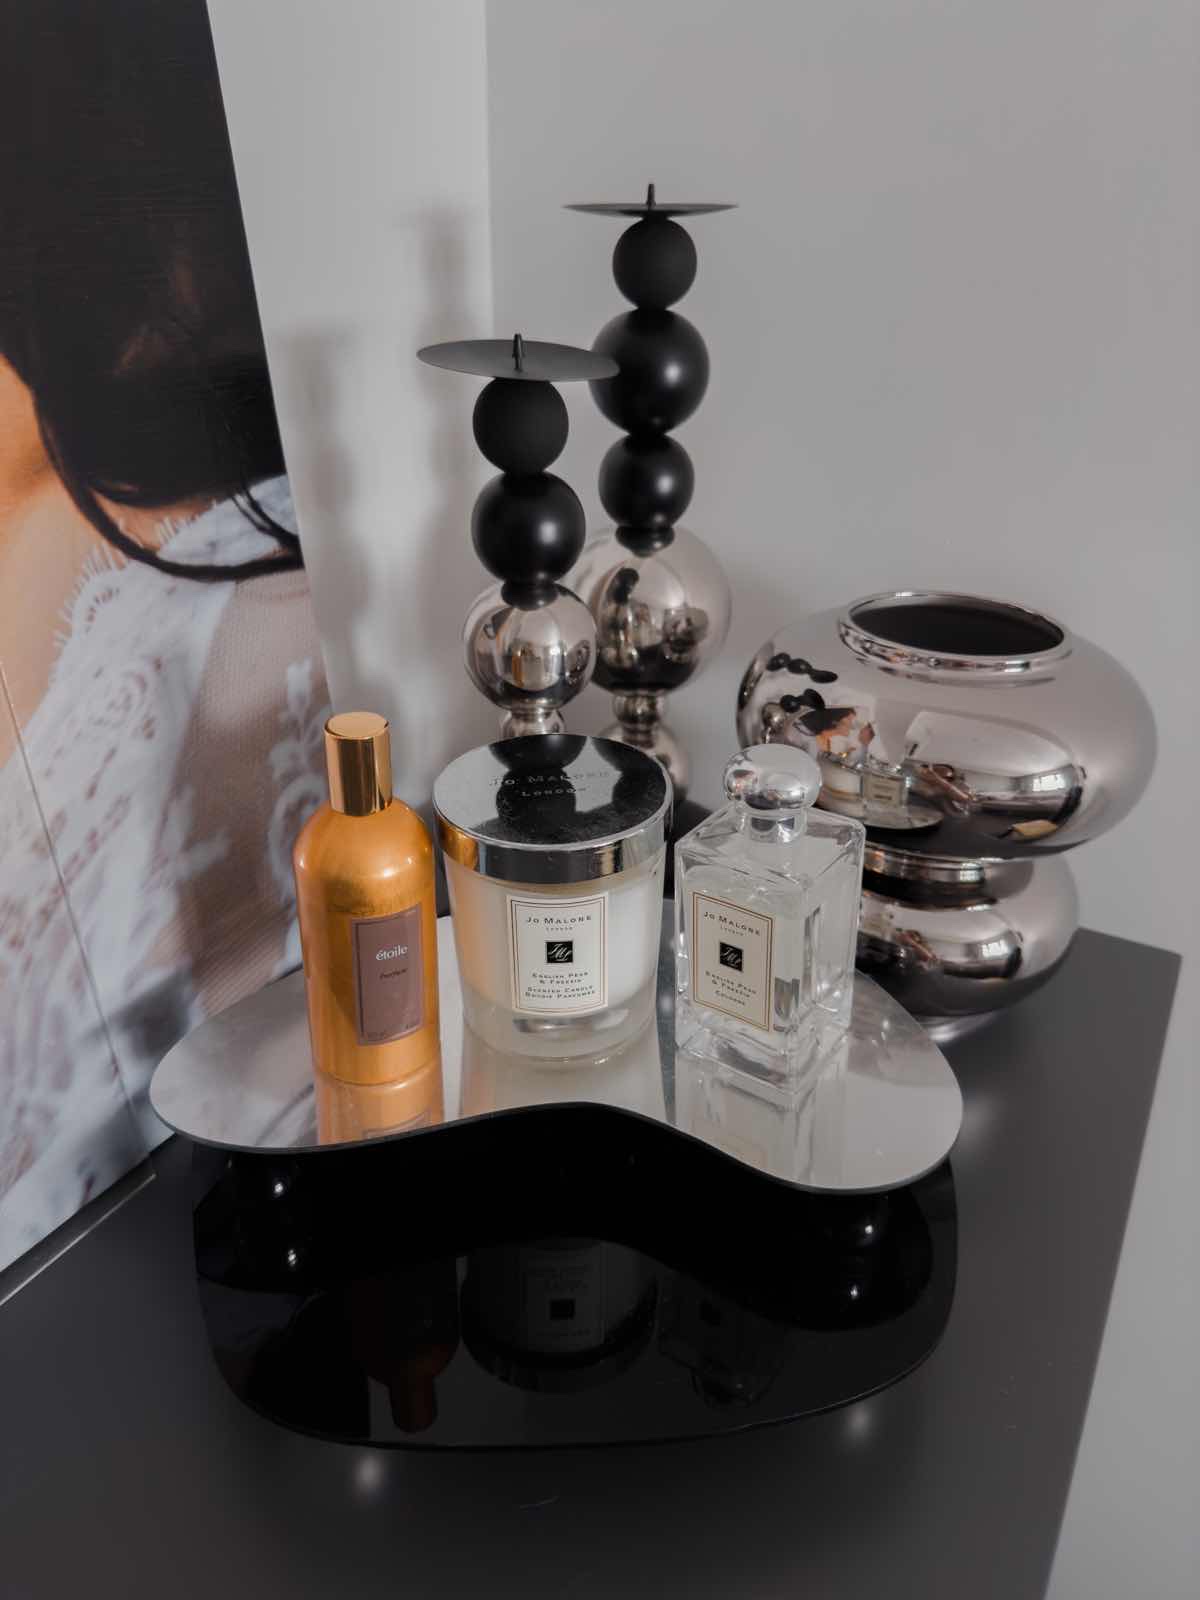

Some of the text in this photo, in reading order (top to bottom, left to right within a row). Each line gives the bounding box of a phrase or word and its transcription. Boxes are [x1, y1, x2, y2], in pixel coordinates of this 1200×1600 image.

[526, 914, 592, 925] JO MALONE
[703, 911, 761, 936] JO MALONE
[376, 944, 408, 961] étoile
